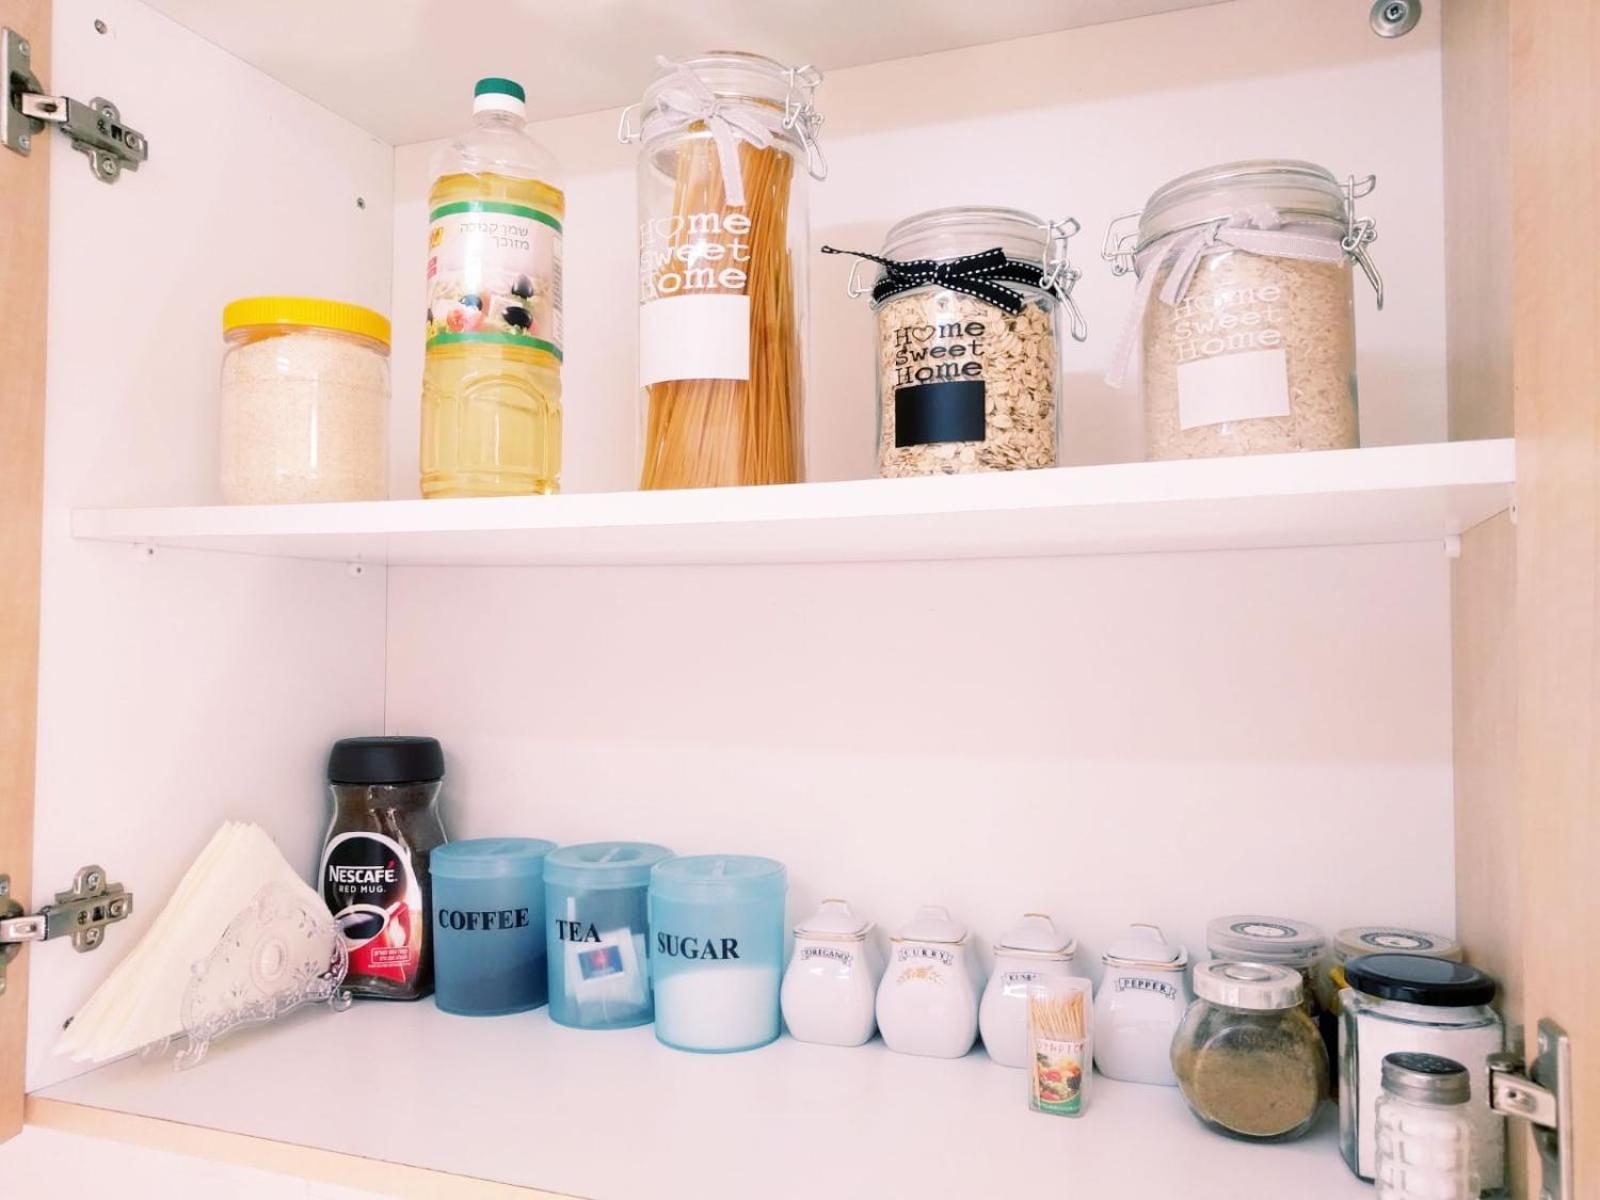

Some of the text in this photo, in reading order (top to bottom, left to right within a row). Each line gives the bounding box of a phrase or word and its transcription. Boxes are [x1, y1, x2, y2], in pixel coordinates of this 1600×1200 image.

[895, 339, 985, 366] Sweet
[1174, 329, 1281, 361] Home
[895, 361, 984, 386] Home
[338, 884, 384, 894] RED MUG
[438, 907, 530, 931] COFFEE
[555, 919, 602, 943] TEA
[657, 931, 740, 961] SUGAR
[902, 948, 945, 960] CURRY
[1124, 979, 1168, 993] PEPPER
